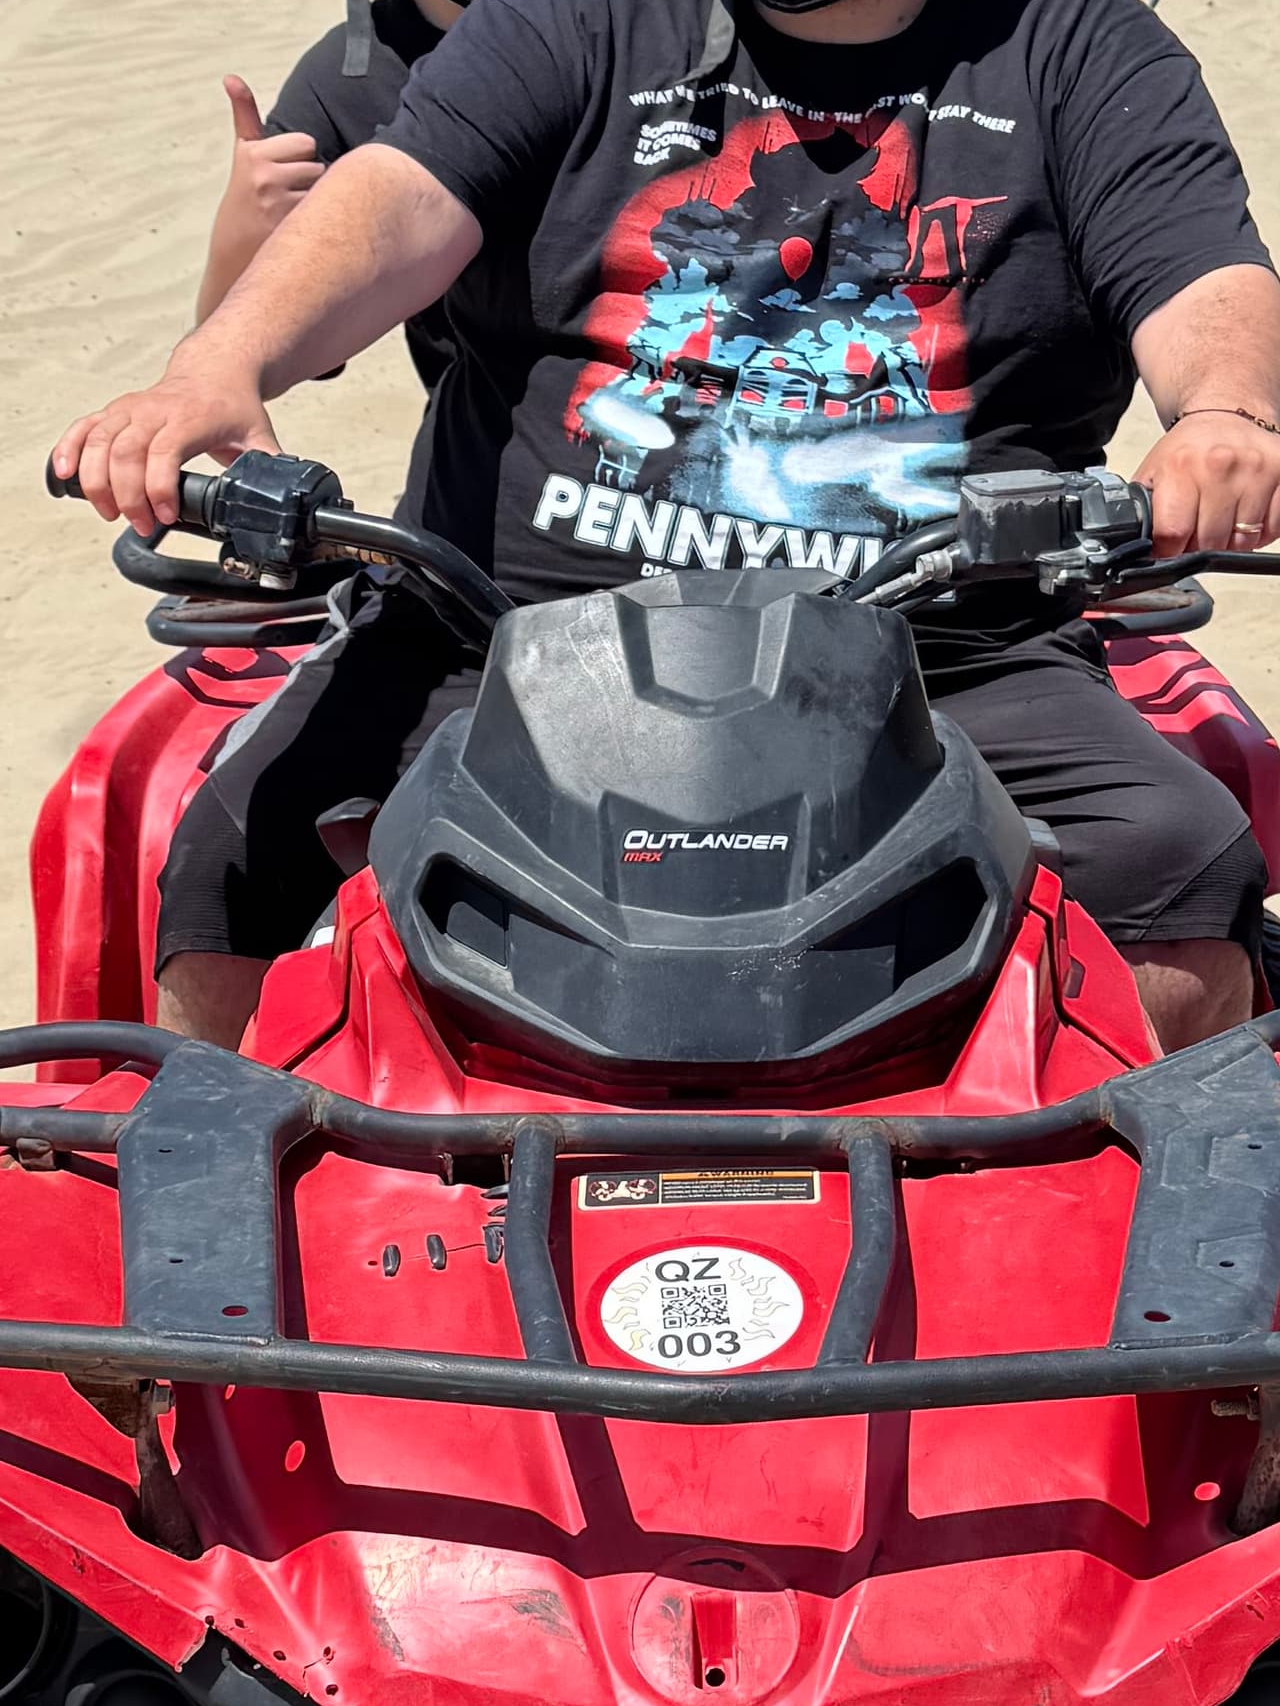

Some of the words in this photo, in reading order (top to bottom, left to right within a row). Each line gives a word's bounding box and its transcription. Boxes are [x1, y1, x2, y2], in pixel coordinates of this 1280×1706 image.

[628, 89, 674, 107] WHAT
[696, 82, 740, 101] TRIED
[741, 87, 760, 106] TO
[761, 94, 805, 117] LEAVE
[807, 109, 825, 123] IN
[833, 111, 863, 124] THE
[936, 104, 972, 121] STAY
[971, 110, 1017, 134] THERE
[636, 136, 652, 153] IT
[652, 132, 702, 152] COMES
[639, 120, 718, 143] SOMETIMES
[632, 147, 672, 166] BACK
[532, 473, 890, 581] PENNYWI
[623, 829, 790, 851] OUTLANDER
[655, 1257, 722, 1283] QZ
[657, 1330, 741, 1359] 003
